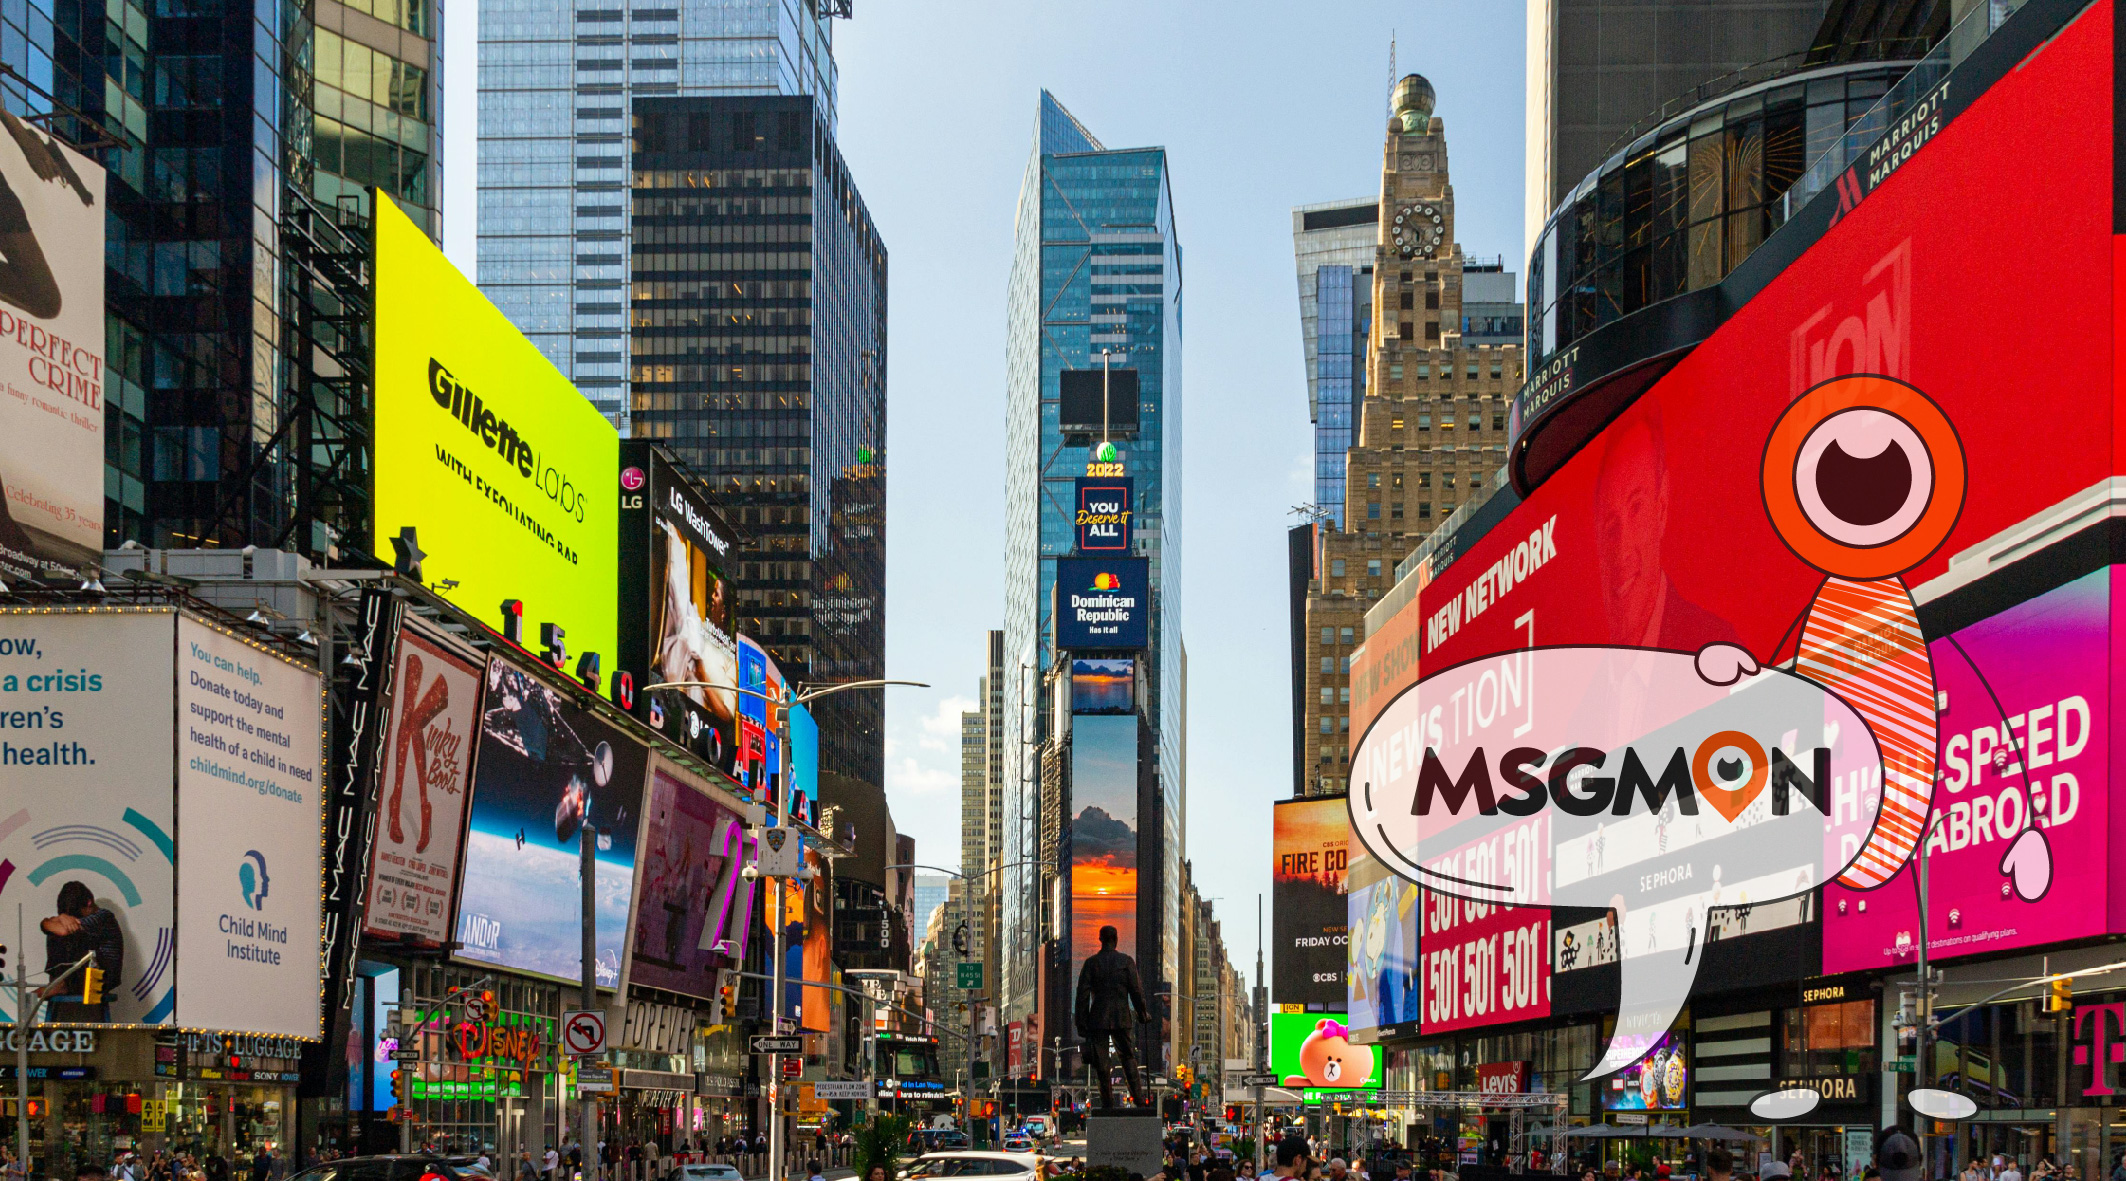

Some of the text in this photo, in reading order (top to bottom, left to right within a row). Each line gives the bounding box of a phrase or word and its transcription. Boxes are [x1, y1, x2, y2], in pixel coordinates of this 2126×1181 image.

[1870, 81, 1950, 166] MARRIOTT
[1869, 116, 1939, 190] MARQUIS
[0, 309, 102, 382] PERFECT
[28, 356, 101, 411] CRIME
[1523, 346, 1580, 402] MARRIOTT
[7, 383, 29, 403] funny
[32, 394, 68, 420] romantic
[70, 412, 98, 433] thriller
[1523, 373, 1570, 422] MARQUIS
[435, 443, 472, 485] WITH
[1086, 463, 1125, 478] 2022
[6, 484, 63, 522] Celebrating
[64, 506, 76, 522] 35
[621, 496, 643, 509] LG
[670, 487, 683, 516] LG
[1089, 502, 1119, 513] YOU
[1076, 509, 1133, 526] Deserve it
[1089, 524, 1119, 537] ALL
[40, 560, 48, 570] at
[1427, 514, 1557, 654] NEW NETWORK
[1071, 594, 1135, 608] Dominican
[1076, 608, 1130, 624] Republic
[1089, 626, 1102, 634] Has
[190, 641, 263, 685] You can help.
[3, 668, 103, 692] a crisis
[190, 670, 284, 720] Donate today and
[190, 702, 291, 748] support the mental
[3, 741, 96, 766] health.
[190, 726, 312, 782] health of a child in need
[190, 756, 303, 804] childmind.org/donate
[426, 757, 461, 795] Boots
[1926, 772, 2080, 857] ABROAD
[1282, 849, 1348, 875] FIRE CO
[1640, 862, 1693, 893] SEPHORA
[219, 914, 287, 945] Child Mind
[881, 910, 889, 948] 1500
[1295, 936, 1331, 947] FRIDAY
[1931, 937, 1963, 949] destinations
[1972, 931, 1999, 943] qualifying
[227, 939, 281, 966] Institute
[1321, 973, 1337, 982] CBS
[1430, 944, 1459, 1024] 501
[1463, 933, 1496, 1018] 501
[1502, 922, 1539, 1011] 501
[1803, 986, 1844, 1002] SEPHORA
[622, 999, 696, 1055] FOREVER
[234, 1035, 302, 1059] LUGGAGE
[201, 1068, 222, 1079] Nikon
[254, 1072, 279, 1080] SONY
[143, 1101, 154, 1127] ATM
[157, 1101, 165, 1127] ATM
